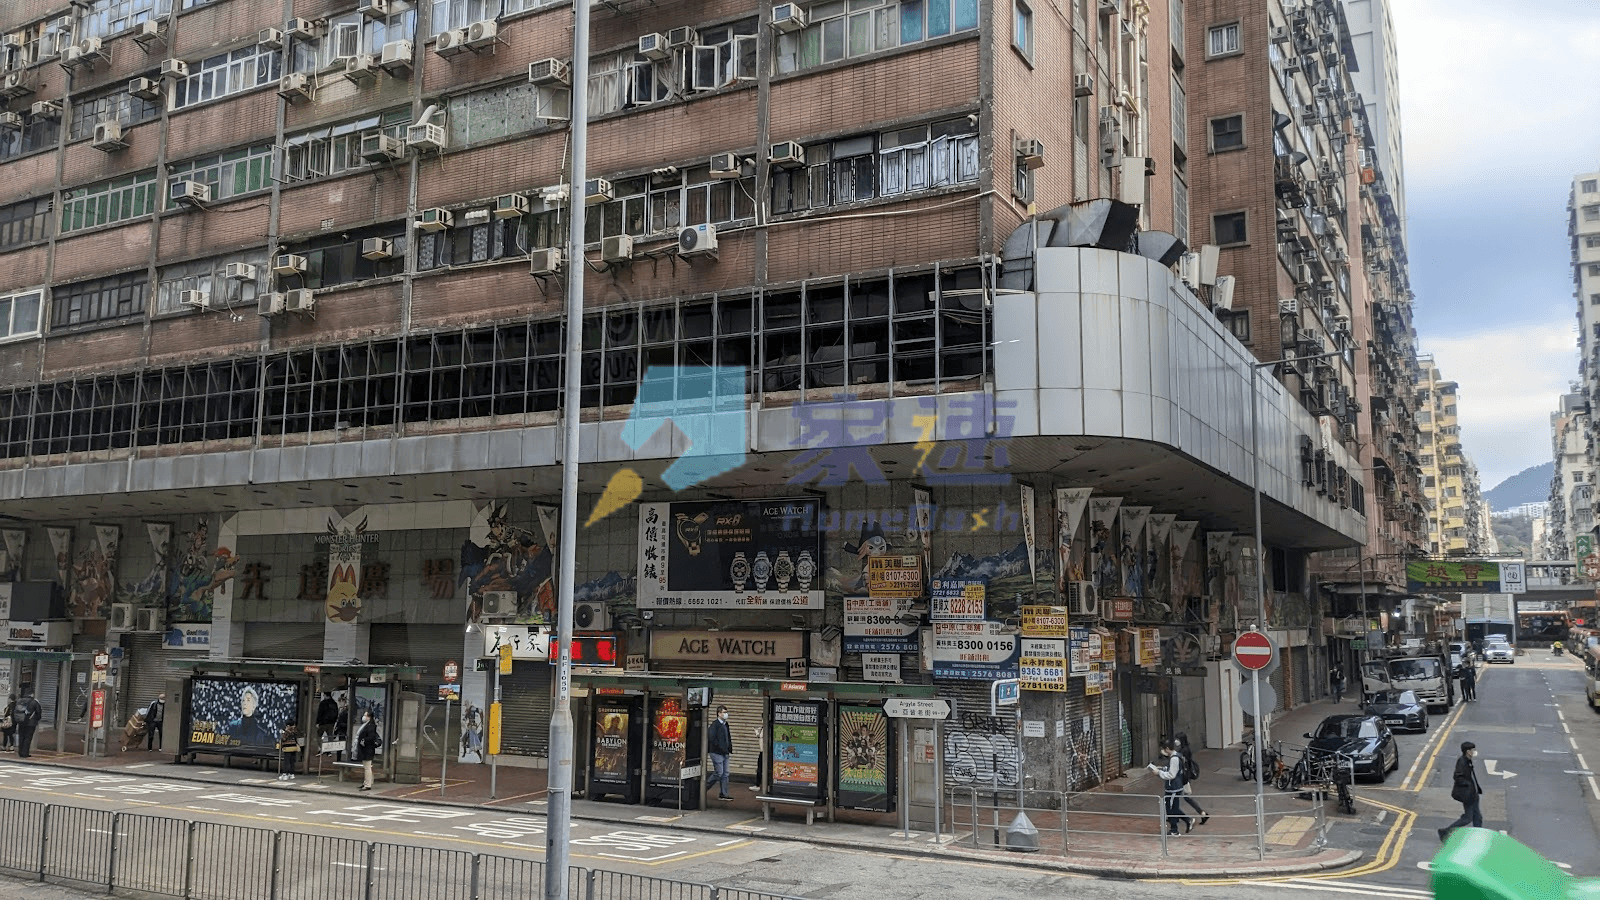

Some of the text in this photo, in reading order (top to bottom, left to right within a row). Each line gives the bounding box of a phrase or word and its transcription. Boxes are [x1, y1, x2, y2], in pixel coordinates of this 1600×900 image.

[762, 502, 809, 516] ACE WATCH
[314, 533, 380, 544] MONSTER HUNTER
[885, 571, 919, 581] 8107-6300
[950, 599, 966, 614] 8228
[967, 599, 983, 614] 2153
[678, 638, 776, 656] ACE WATCH
[957, 640, 983, 650] 8300
[986, 641, 1013, 651] 0156
[1021, 667, 1064, 677] 9363 6681
[1021, 681, 1065, 690] 27811682
[191, 731, 215, 744] EDAN
[653, 741, 685, 749] BABYLON
